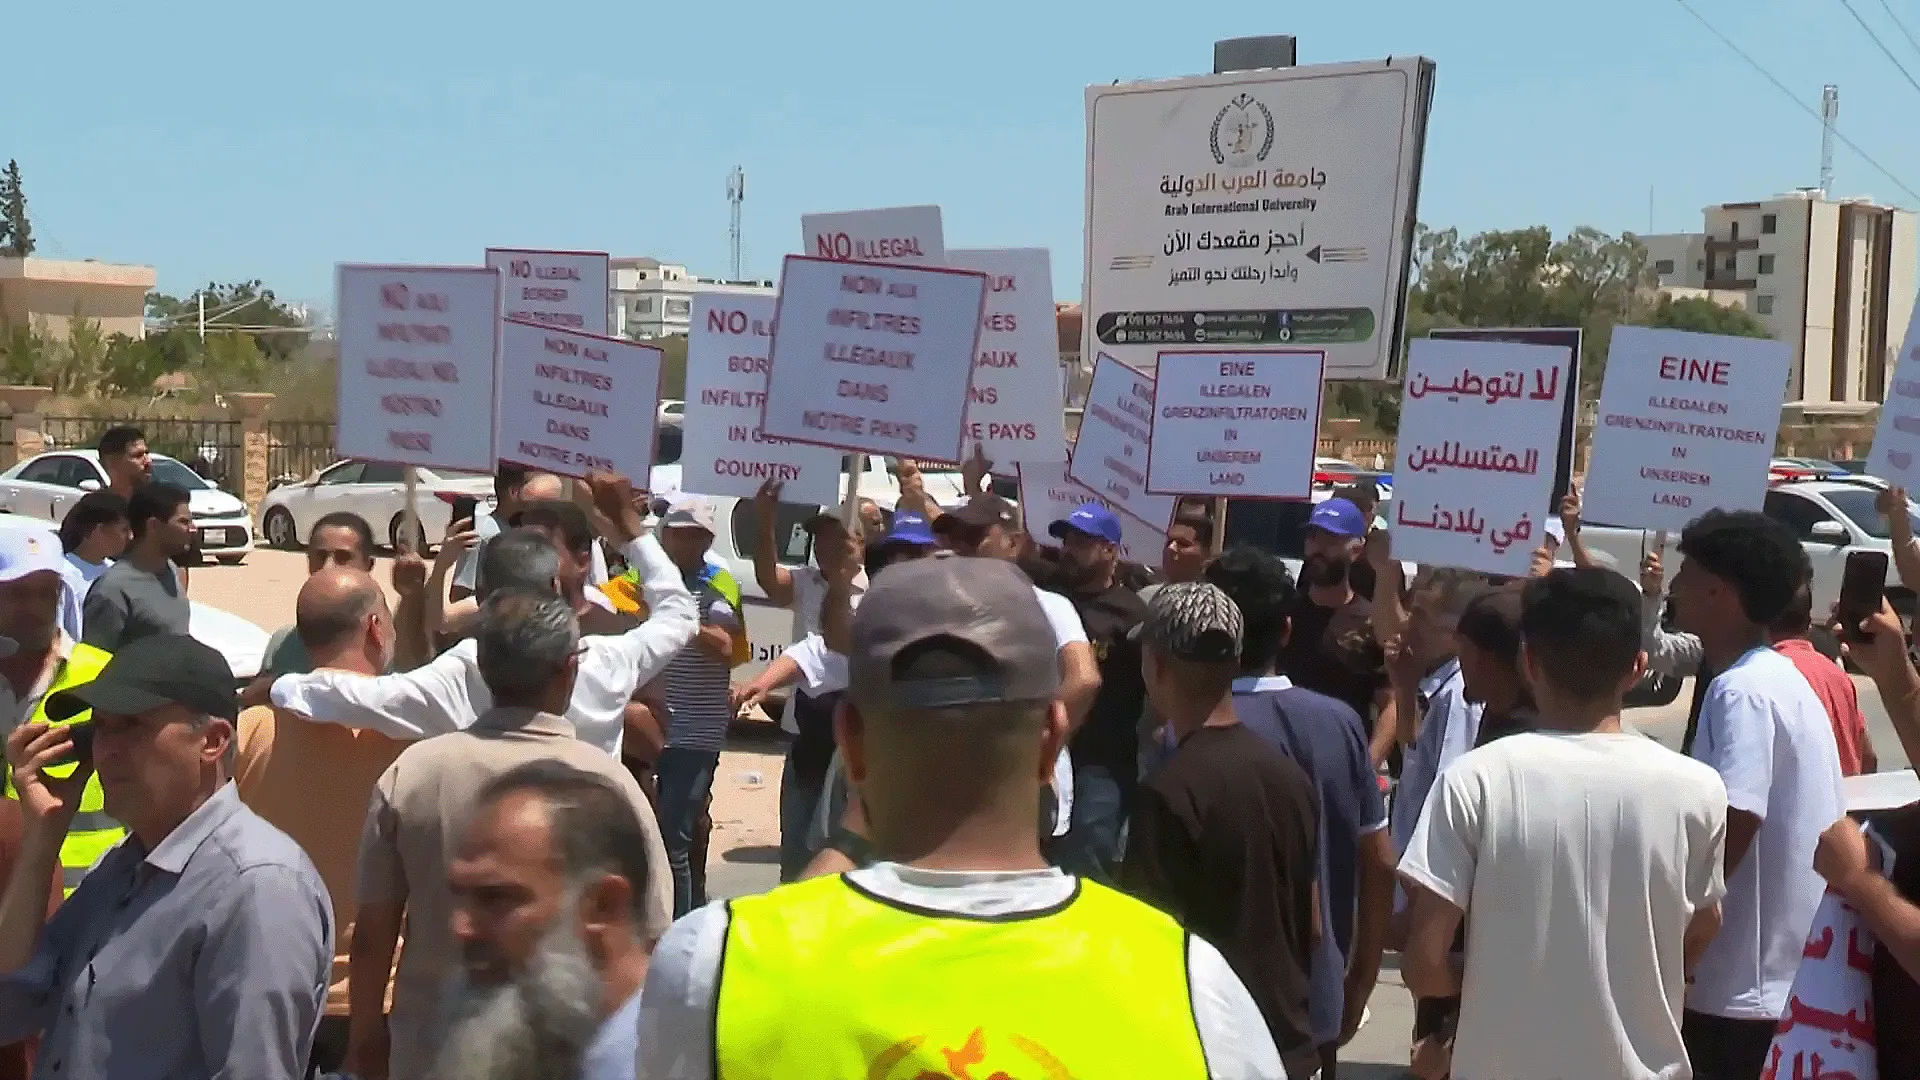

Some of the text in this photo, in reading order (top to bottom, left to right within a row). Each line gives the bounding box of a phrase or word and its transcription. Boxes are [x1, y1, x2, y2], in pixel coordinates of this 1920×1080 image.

[1160, 166, 1327, 198] جامعة العرب الدولية
[1165, 198, 1317, 217] Arab International University
[817, 231, 924, 259] NO ILLEGAL
[1196, 230, 1260, 251] مقعدك
[509, 260, 531, 279] NO
[707, 309, 749, 335] NO
[727, 355, 769, 374] BOR
[1220, 361, 1255, 377] EINE
[1660, 356, 1731, 385] EINE
[1200, 383, 1271, 399] ILLEGALEN
[1410, 366, 1559, 404] لا لتوطين
[1162, 405, 1307, 420] GRENZINFILTRATOREN
[1648, 396, 1729, 414] ILLEGALEN
[728, 425, 747, 442] IN
[988, 423, 1036, 441] PAYS
[1224, 429, 1238, 441] IN
[1605, 414, 1766, 444] GRENZINFILTRATOREN
[1408, 440, 1539, 475] المتسللين
[1672, 446, 1687, 459] IN
[714, 457, 802, 481] COUNTRY
[1209, 472, 1245, 485] LAND
[1640, 466, 1711, 486] UNSEREM
[1652, 493, 1693, 509] LAND
[1398, 500, 1532, 554] في بلادنا
